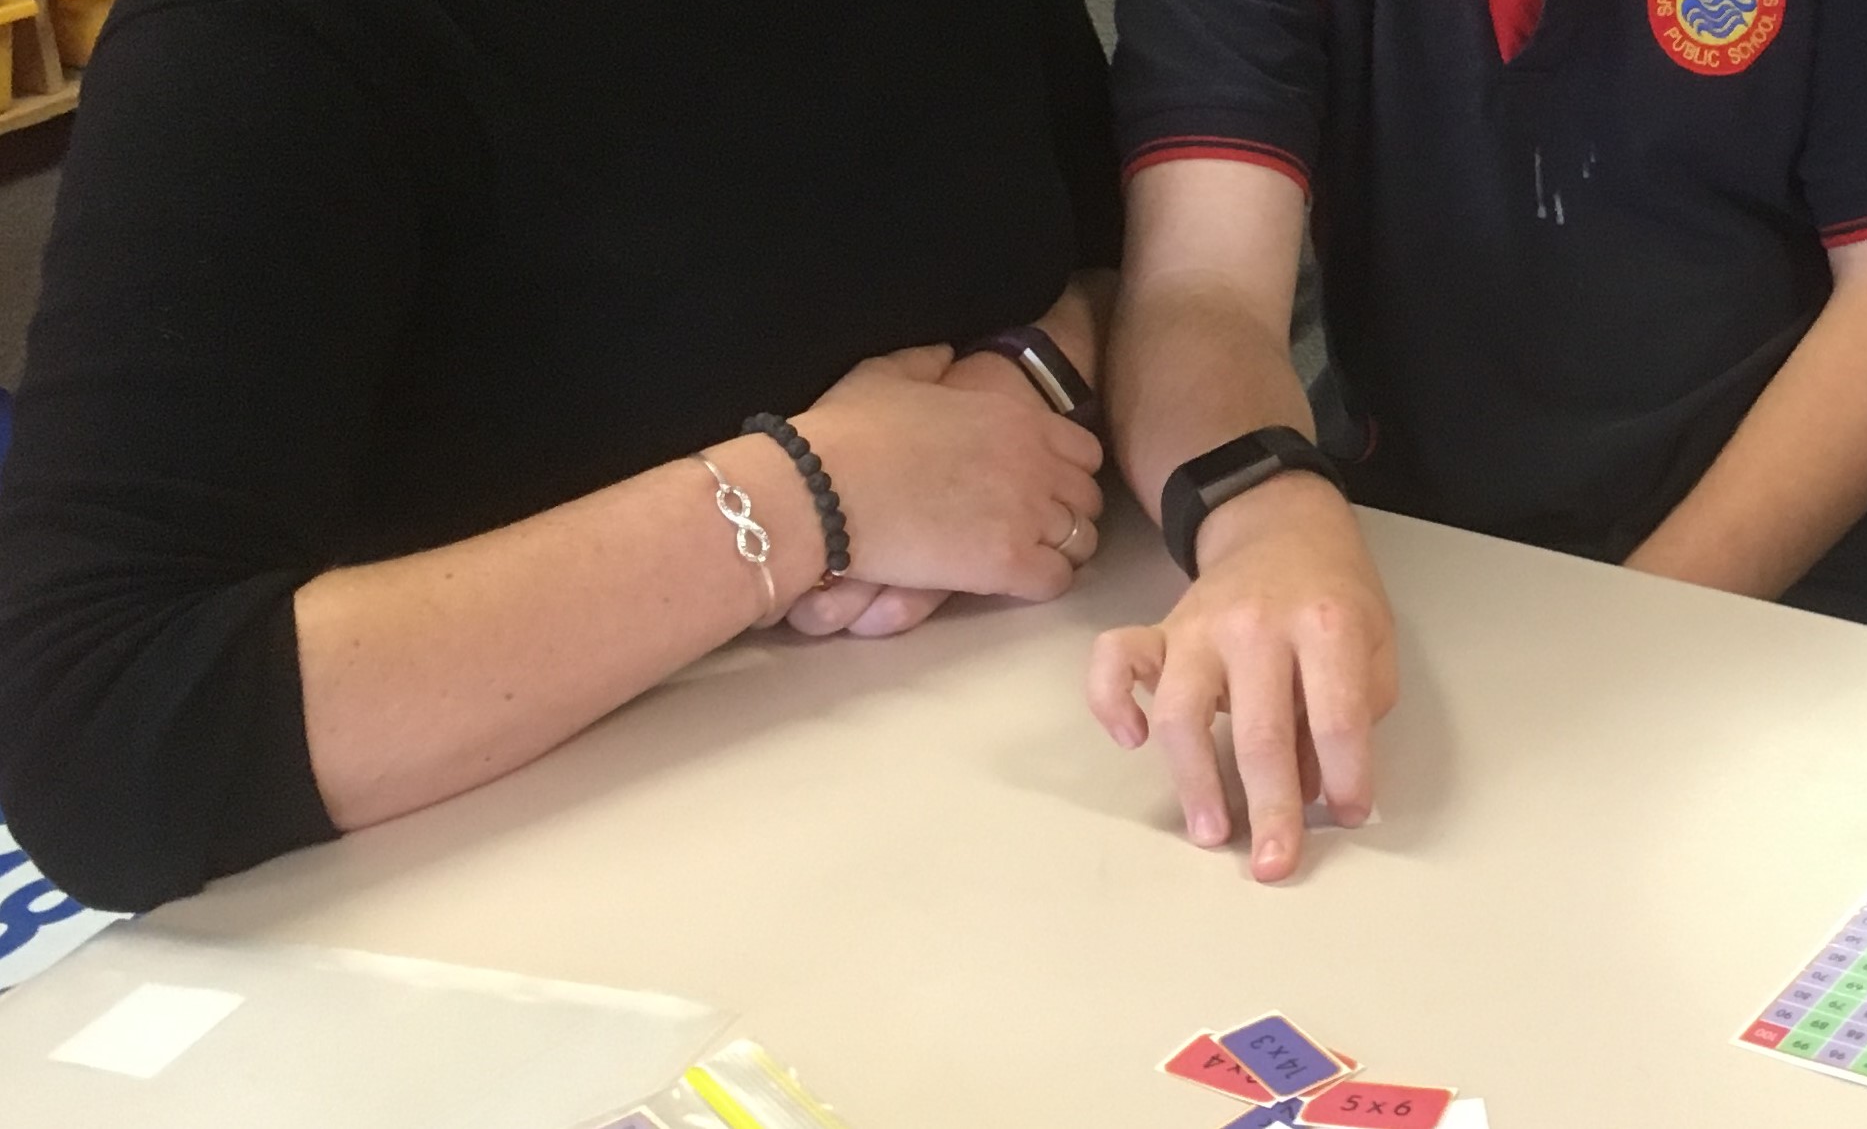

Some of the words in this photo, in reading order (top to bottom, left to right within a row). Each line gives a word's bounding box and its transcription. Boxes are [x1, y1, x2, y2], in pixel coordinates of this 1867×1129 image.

[1664, 27, 1720, 68] PUBLIC
[1728, 13, 1777, 64] SCHOOL
[1754, 1028, 1778, 1042] 100
[1340, 1094, 1363, 1112] 5
[1393, 1099, 1413, 1116] 6
